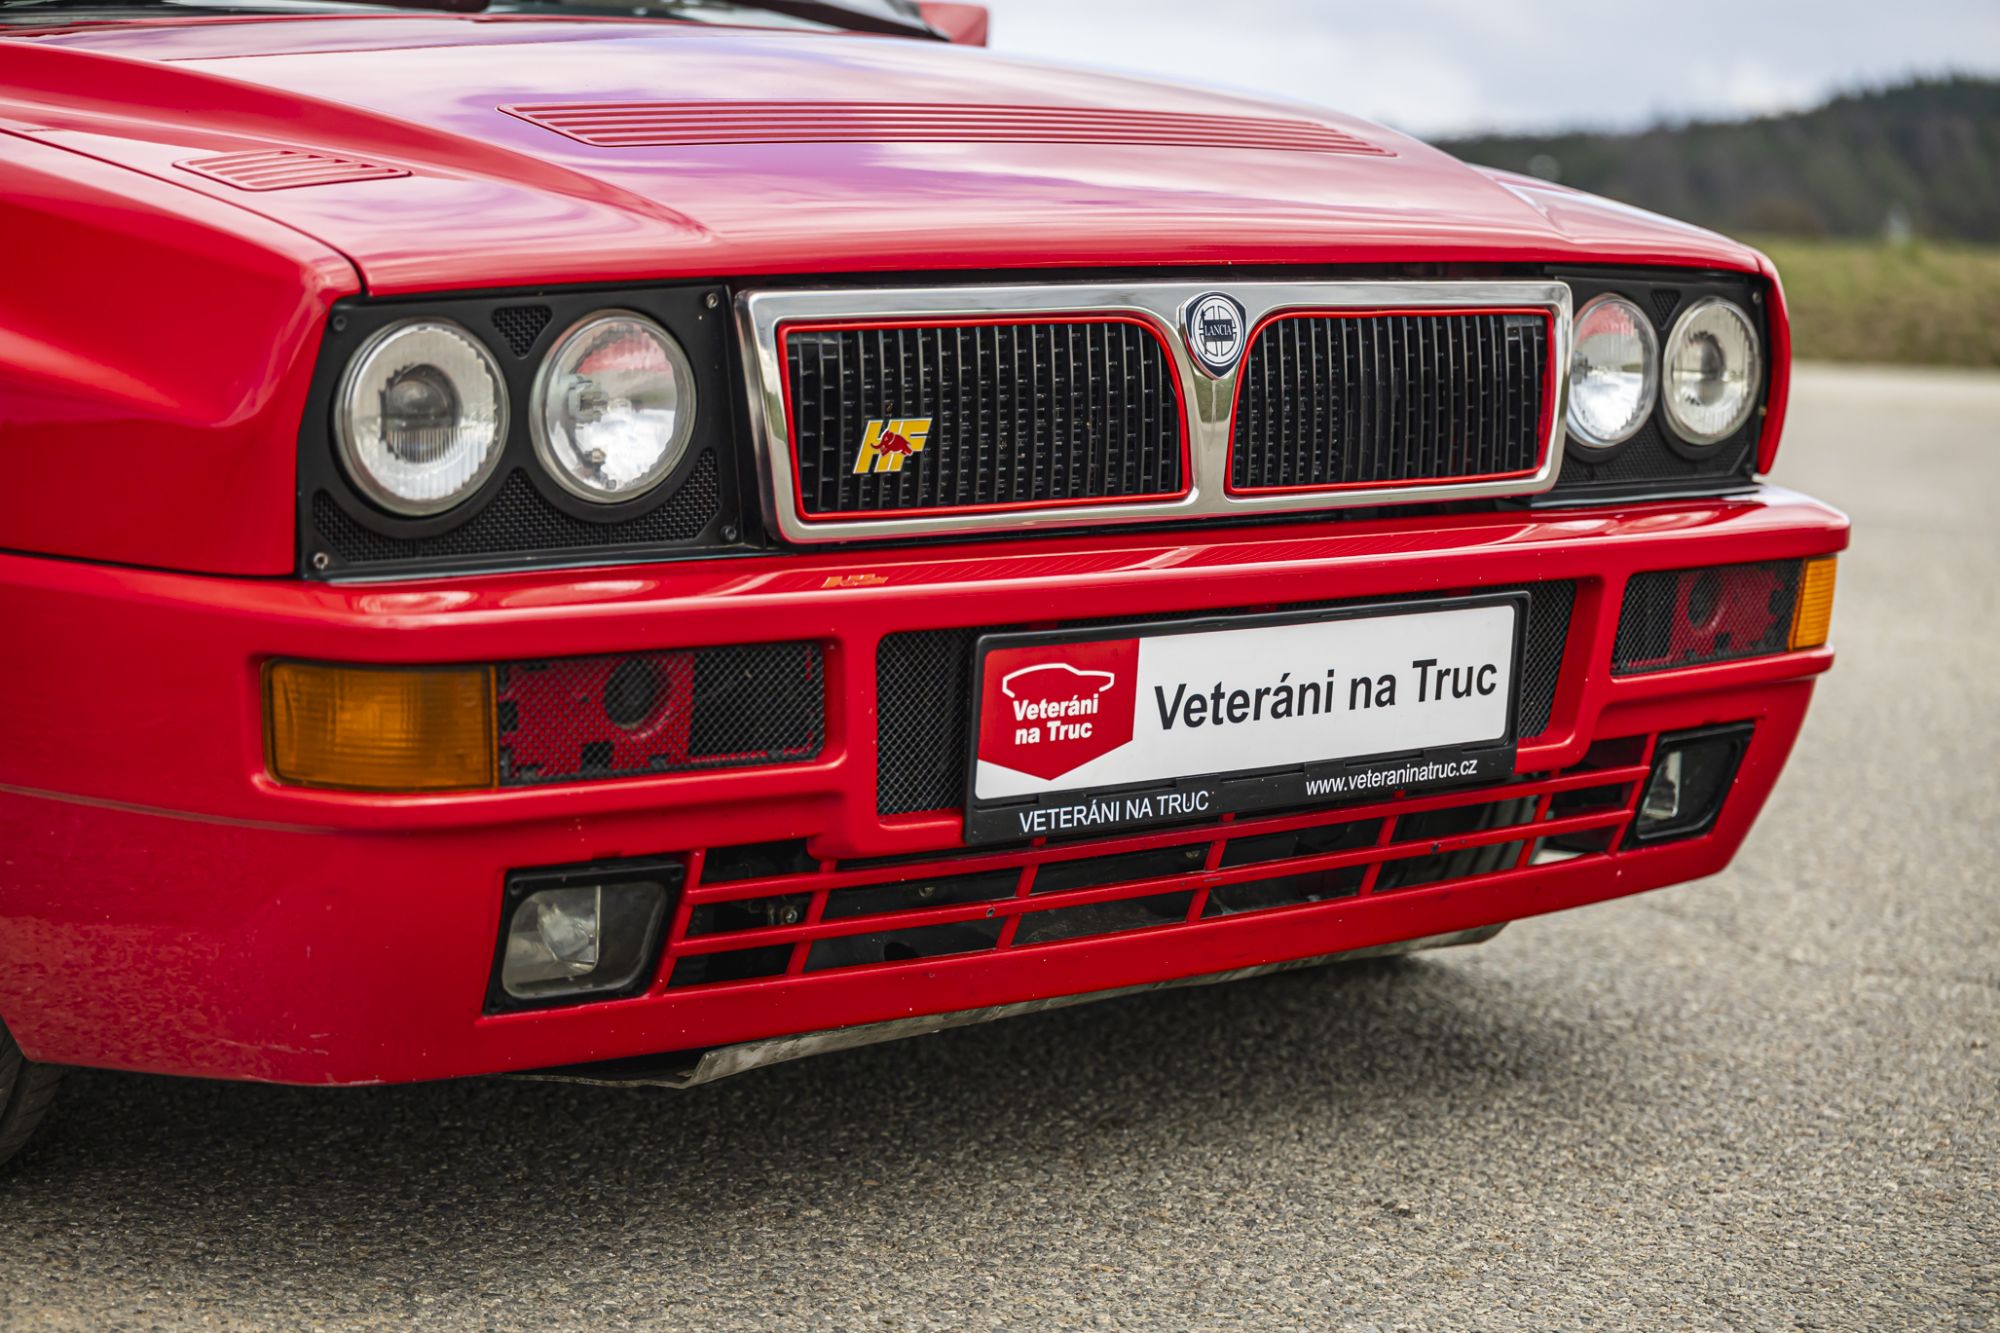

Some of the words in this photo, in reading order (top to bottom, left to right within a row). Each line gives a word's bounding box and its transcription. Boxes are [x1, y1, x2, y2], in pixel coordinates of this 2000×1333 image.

[1204, 324, 1233, 336] LANCIA
[853, 417, 933, 475] HF
[1013, 693, 1099, 721] Veteráni
[1154, 668, 1335, 731] Veteráni
[1349, 672, 1397, 711] na
[1412, 658, 1498, 703] Truc
[1015, 727, 1041, 745] na
[1046, 721, 1093, 742] Truc
[1305, 759, 1478, 796] www.veteraninatruc.cz
[1019, 799, 1120, 833] VETERÁNI
[1125, 798, 1153, 820] NA
[1156, 790, 1210, 816] TRUC
